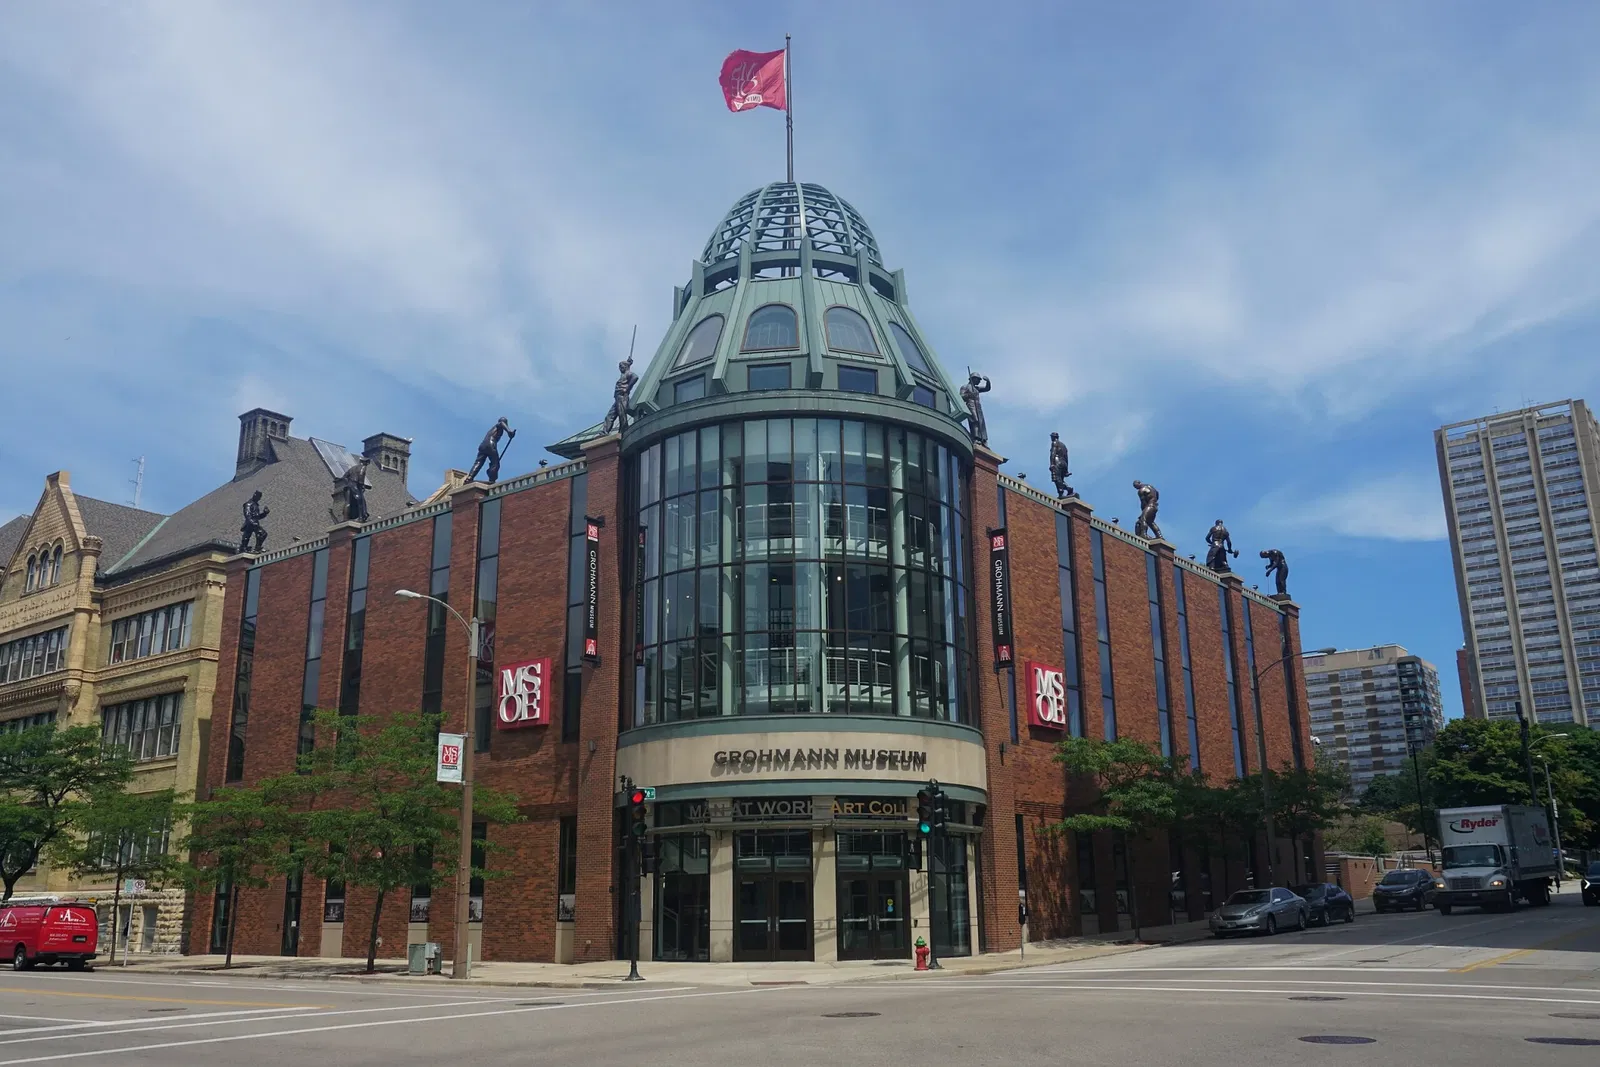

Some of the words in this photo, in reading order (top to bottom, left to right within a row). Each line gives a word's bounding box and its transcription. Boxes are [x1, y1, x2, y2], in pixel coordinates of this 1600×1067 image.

[589, 550, 597, 605] GROHMANN
[994, 559, 1004, 612] GROHMANN
[713, 748, 840, 766] GROHMANN
[844, 748, 927, 766] MUSEUM
[731, 801, 754, 817] AT
[1461, 818, 1498, 830] Ryder
